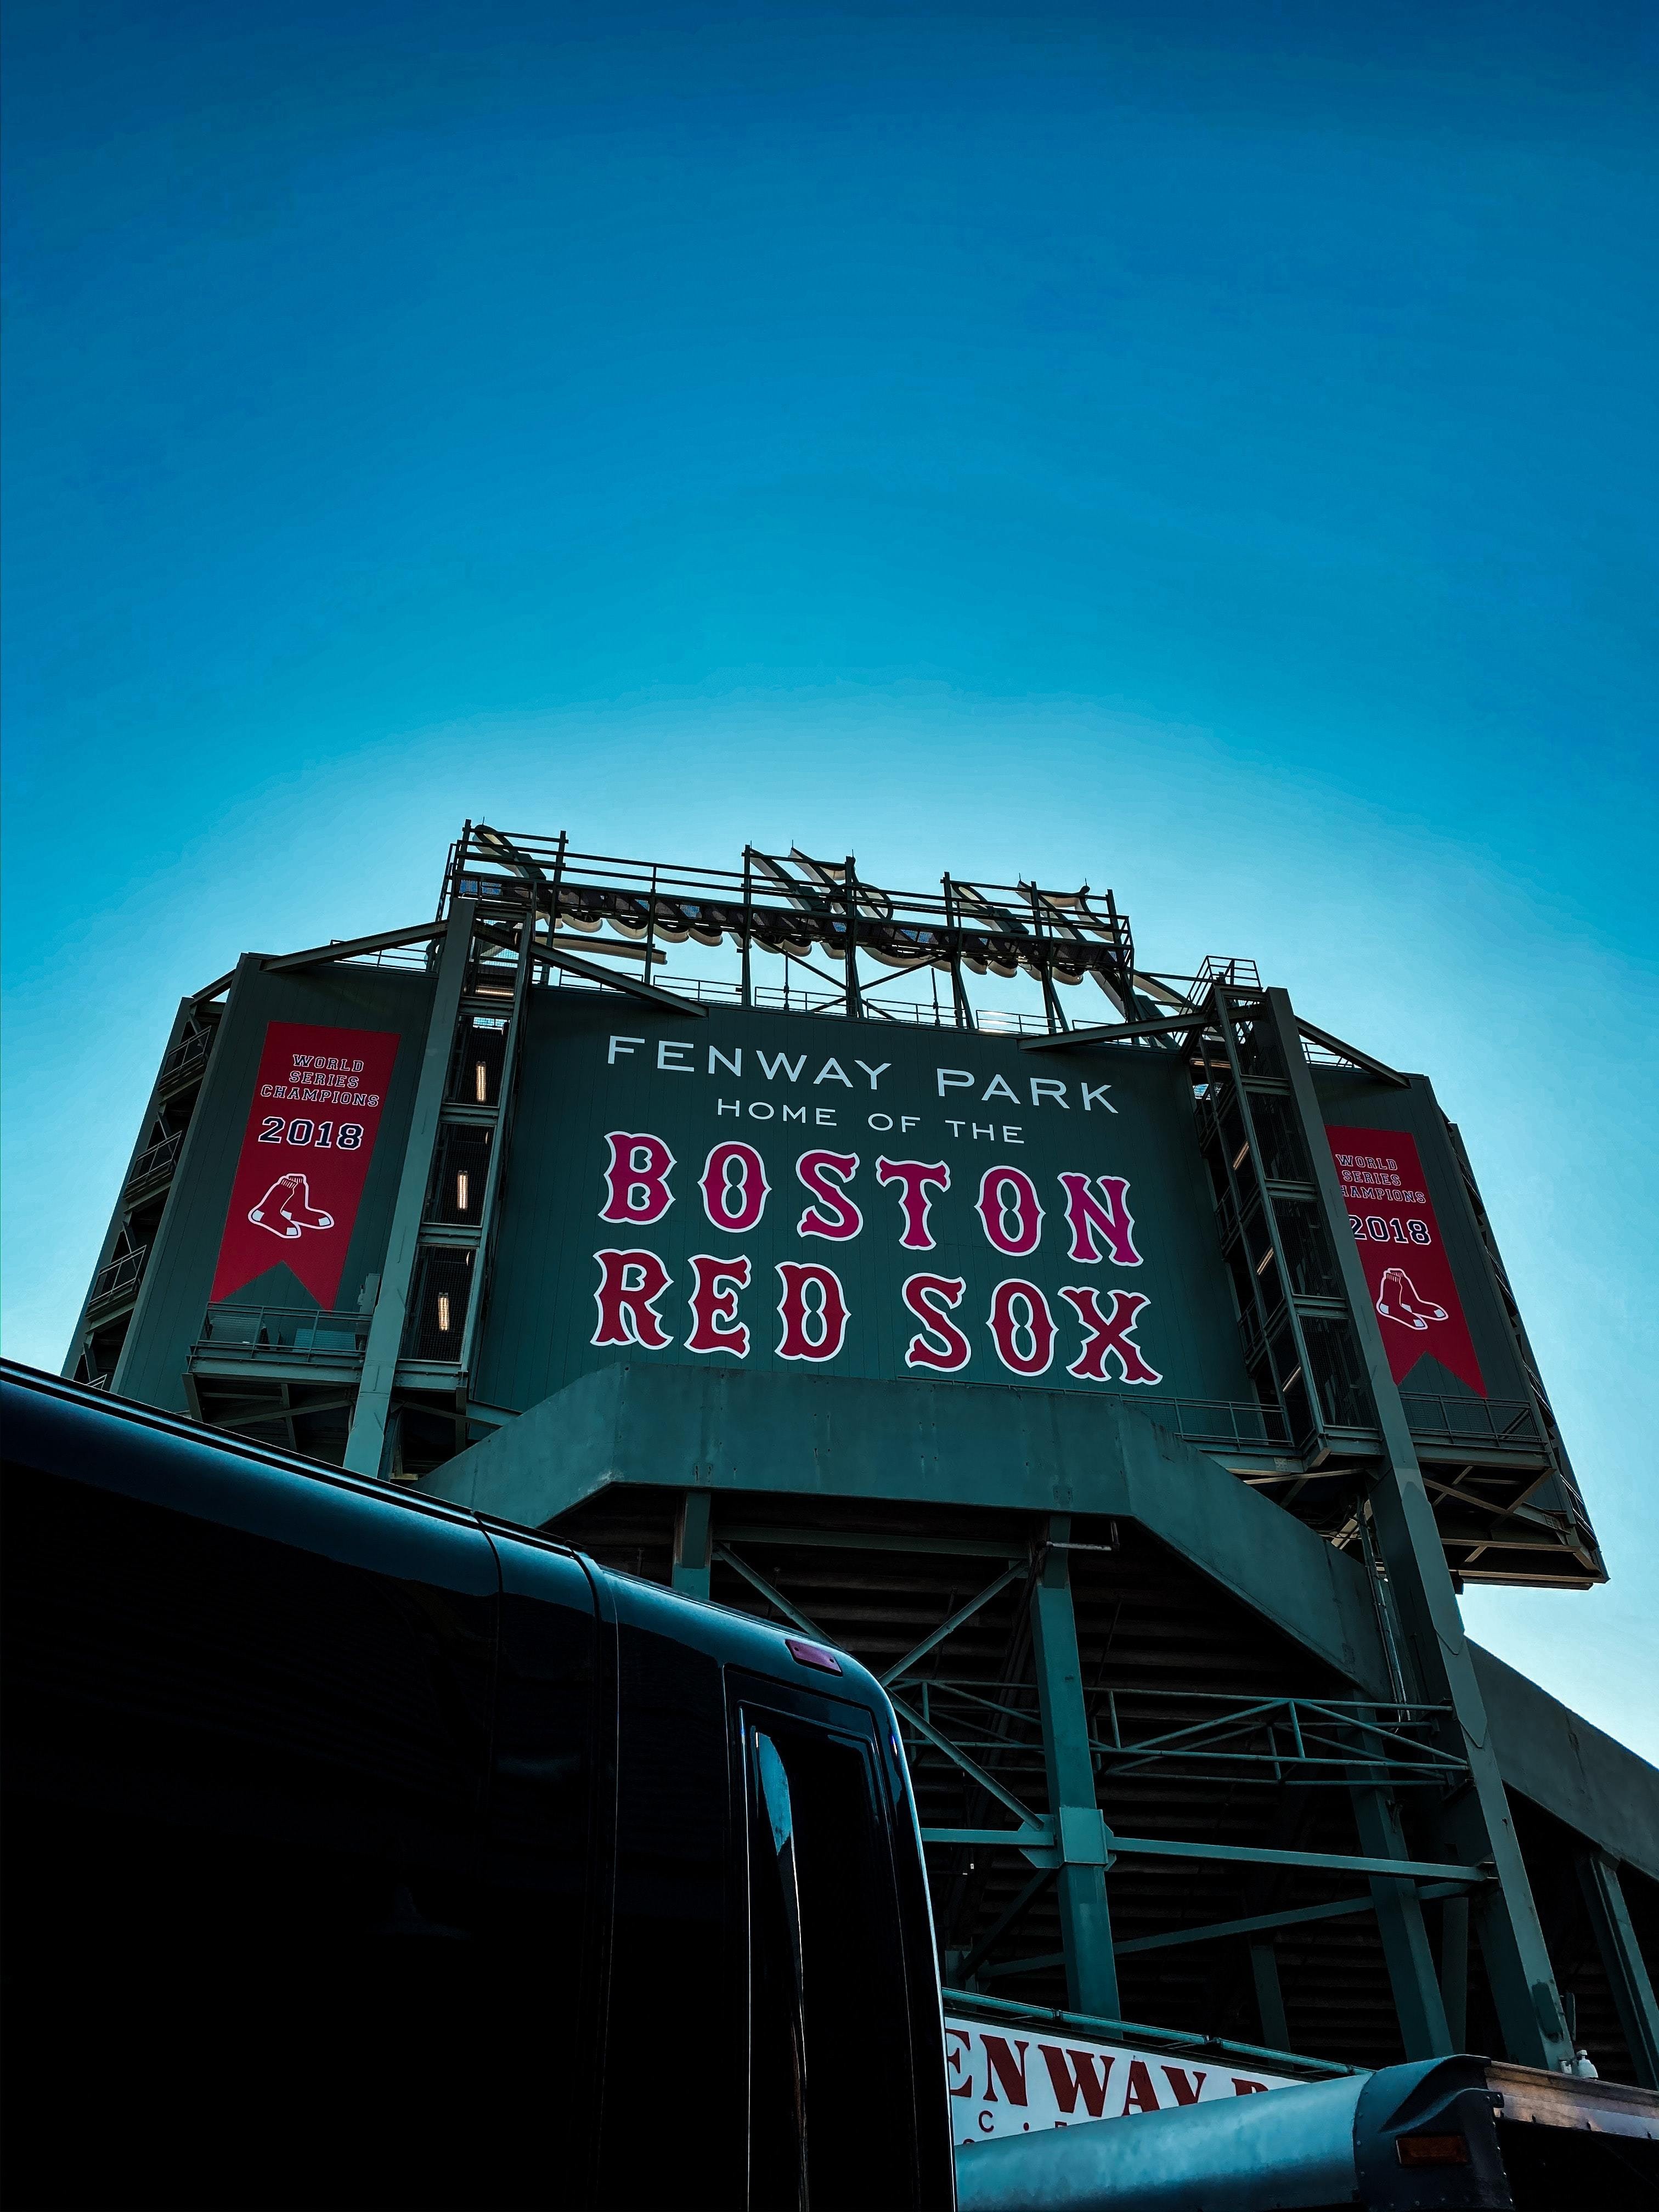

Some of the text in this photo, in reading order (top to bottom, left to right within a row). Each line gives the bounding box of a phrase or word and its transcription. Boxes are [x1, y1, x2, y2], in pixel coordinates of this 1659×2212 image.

[289, 1070, 359, 1088] SERIES
[292, 1054, 364, 1073] WORLD
[607, 1035, 1119, 1114] FENWAY PARK
[260, 1084, 380, 1107] CHAMPIONS
[257, 1116, 364, 1150] 2018
[717, 1098, 1025, 1144] HOME OF THE
[1335, 1154, 1398, 1171] WORLD
[1342, 1170, 1402, 1186] SERIES
[597, 1130, 1145, 1268] BOSTON
[1340, 1184, 1426, 1204] HAMPIONS
[1348, 1214, 1432, 1245] 2018
[589, 1248, 1164, 1386] RED SOX
[945, 2028, 1206, 2117] ENWAY
